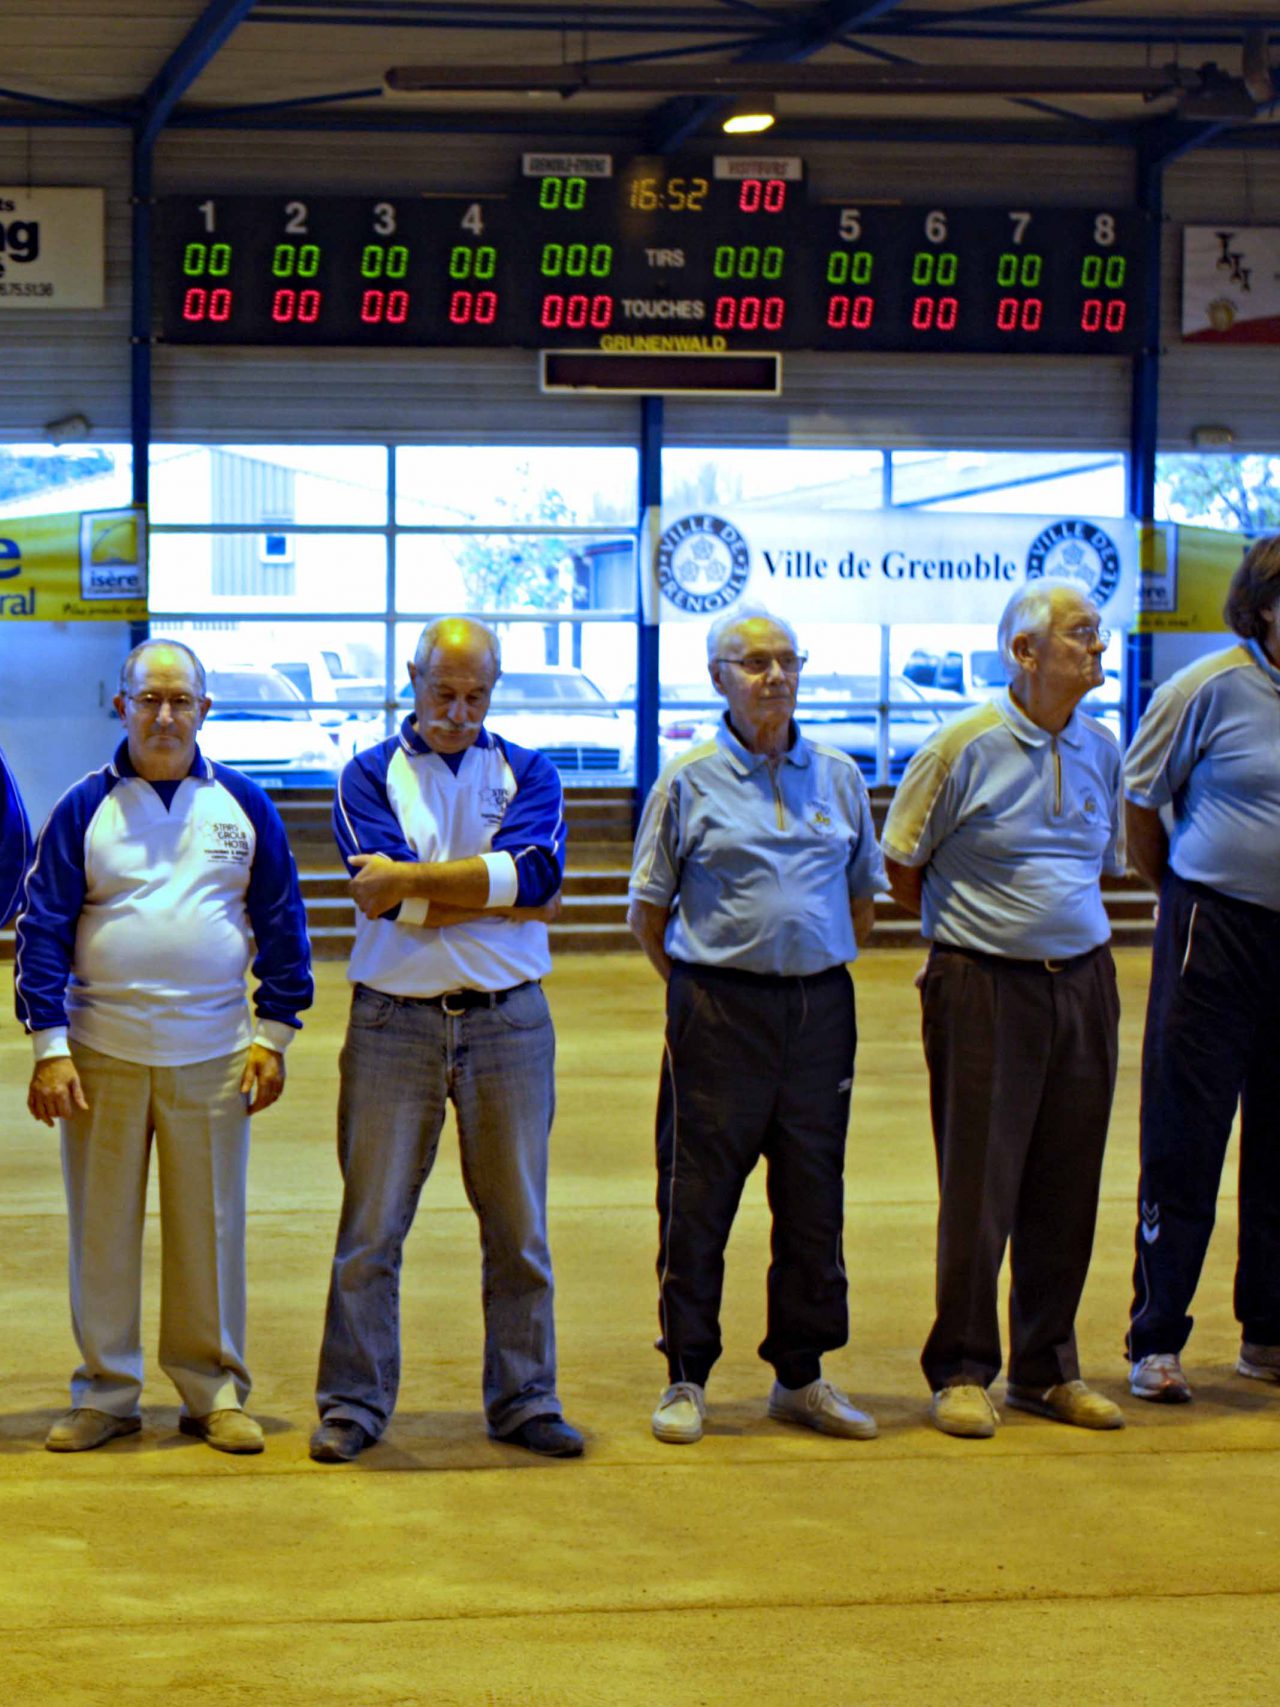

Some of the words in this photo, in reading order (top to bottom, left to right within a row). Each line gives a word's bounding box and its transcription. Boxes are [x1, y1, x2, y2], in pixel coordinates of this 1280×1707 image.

[539, 177, 587, 210] 00
[630, 178, 709, 211] 16:52
[739, 179, 787, 212] 00
[199, 200, 215, 233] 1
[285, 202, 308, 234] 2
[373, 204, 396, 235] 3
[460, 204, 484, 235] 4
[839, 210, 861, 241] 5
[925, 211, 947, 243] 6
[1008, 212, 1032, 244] 7
[1093, 213, 1116, 246] 8
[184, 243, 232, 277] 00
[272, 244, 321, 277] 00
[361, 245, 409, 278] 00
[449, 246, 497, 279] 00
[540, 244, 612, 277] 000
[646, 248, 685, 268] TIRS
[714, 246, 785, 279] 000
[827, 251, 873, 285] 00
[912, 252, 958, 286] 00
[996, 253, 1043, 287] 00
[1081, 255, 1127, 288] 00
[183, 288, 232, 322] 00
[272, 289, 321, 323] 00
[361, 290, 409, 323] 00
[449, 291, 497, 324] 00
[541, 295, 613, 328] 000
[621, 299, 705, 319] TOUCHES
[714, 296, 785, 330] 000
[827, 296, 874, 329] 00
[912, 297, 958, 330] 00
[996, 298, 1043, 331] 00
[1081, 299, 1127, 332] 00
[600, 335, 727, 352] GRUNENWALD
[660, 516, 713, 551] VILLE
[720, 525, 745, 554] DE
[1031, 522, 1083, 555] VILLE
[1091, 531, 1116, 560] DE
[91, 570, 138, 587] isère
[762, 549, 828, 579] Ville
[837, 550, 871, 580] de
[881, 550, 1017, 582] Grenoble
[658, 565, 748, 613] GRENOBLE
[213, 823, 239, 832] STARS
